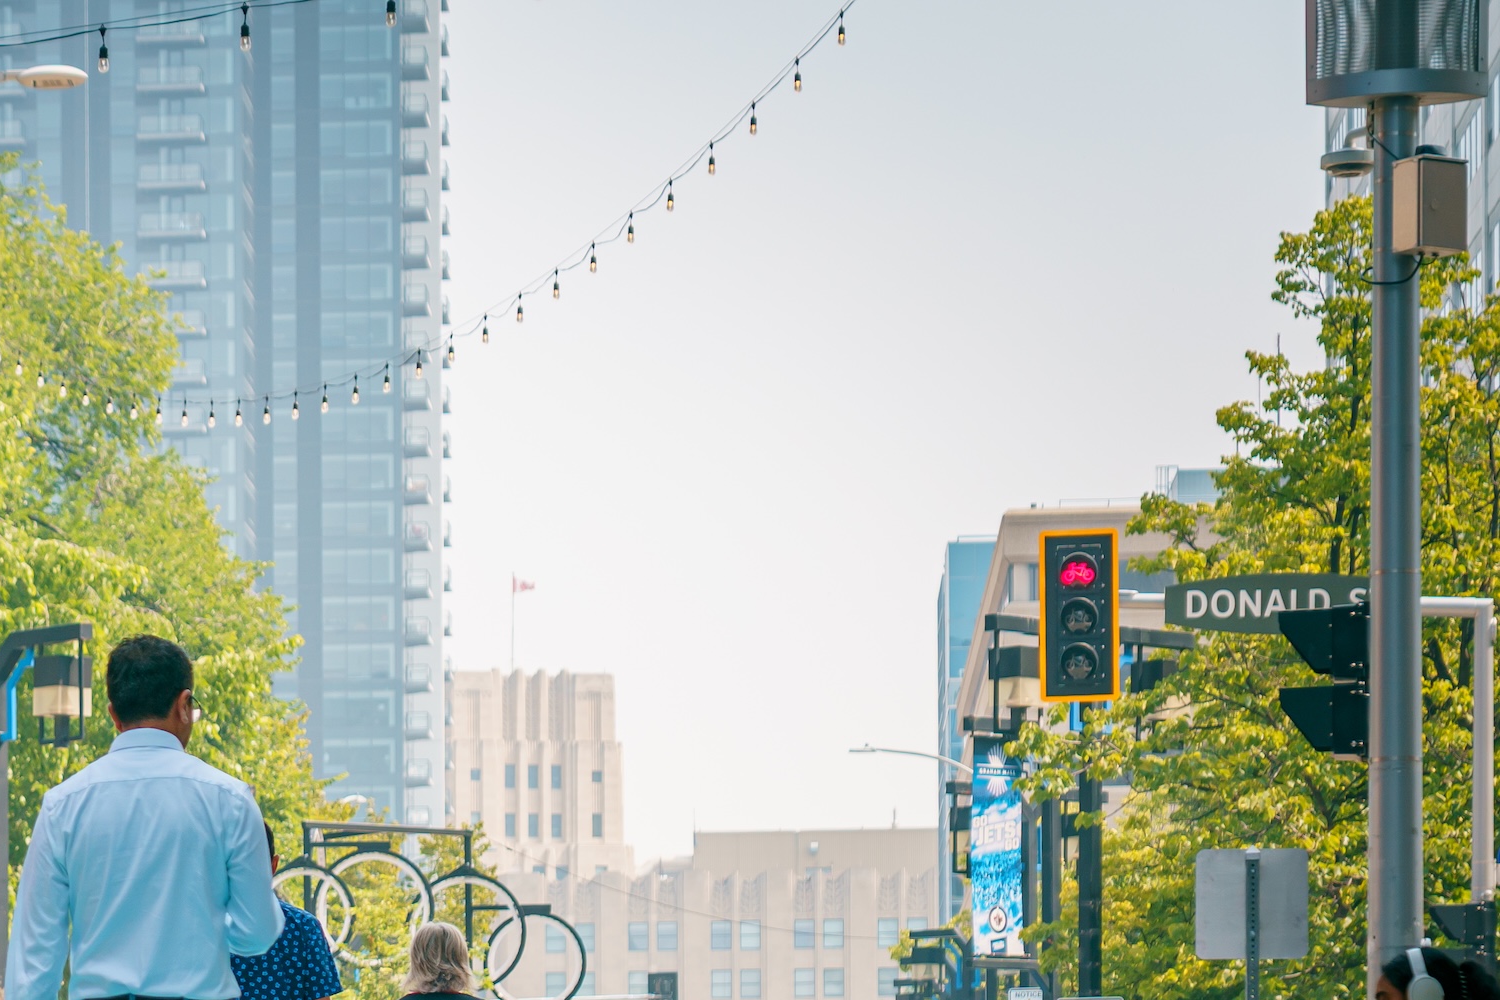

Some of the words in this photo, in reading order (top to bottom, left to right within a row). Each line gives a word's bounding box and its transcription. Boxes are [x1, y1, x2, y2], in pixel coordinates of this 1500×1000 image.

[973, 815, 988, 828] GO
[975, 821, 1016, 846] JETS
[1005, 838, 1019, 850] GO
[1015, 990, 1042, 998] NOTICE
